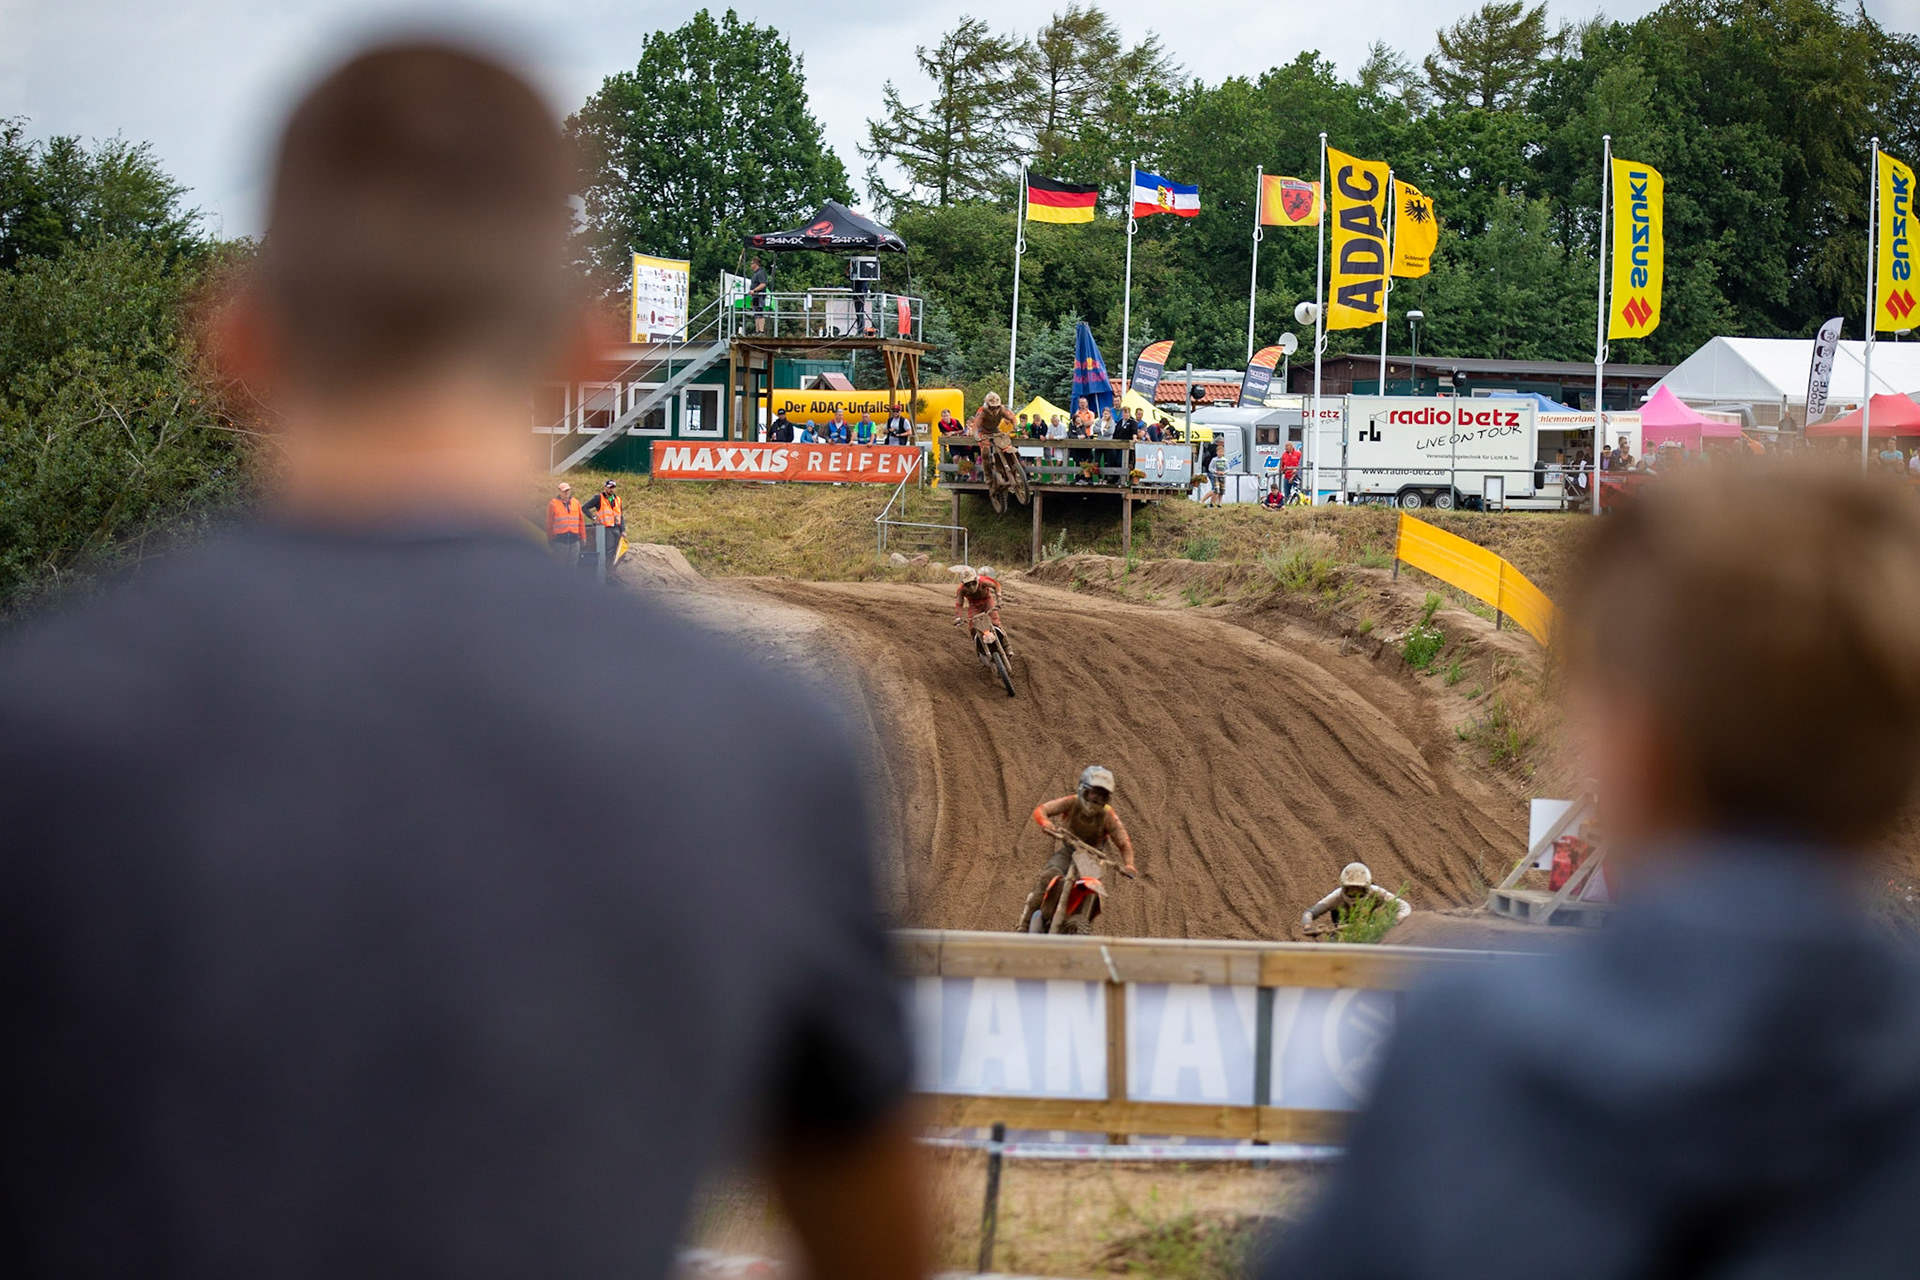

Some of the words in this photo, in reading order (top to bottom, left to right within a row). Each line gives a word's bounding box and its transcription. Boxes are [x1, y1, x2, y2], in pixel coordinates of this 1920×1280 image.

[1337, 166, 1385, 313] ADAC
[785, 401, 806, 412] Der
[1390, 408, 1451, 425] radio
[1458, 408, 1519, 426] betz
[1416, 435, 1447, 450] LIVE
[1449, 432, 1474, 444] ON
[1477, 422, 1522, 439] TOUR
[807, 451, 912, 473] REIFEN
